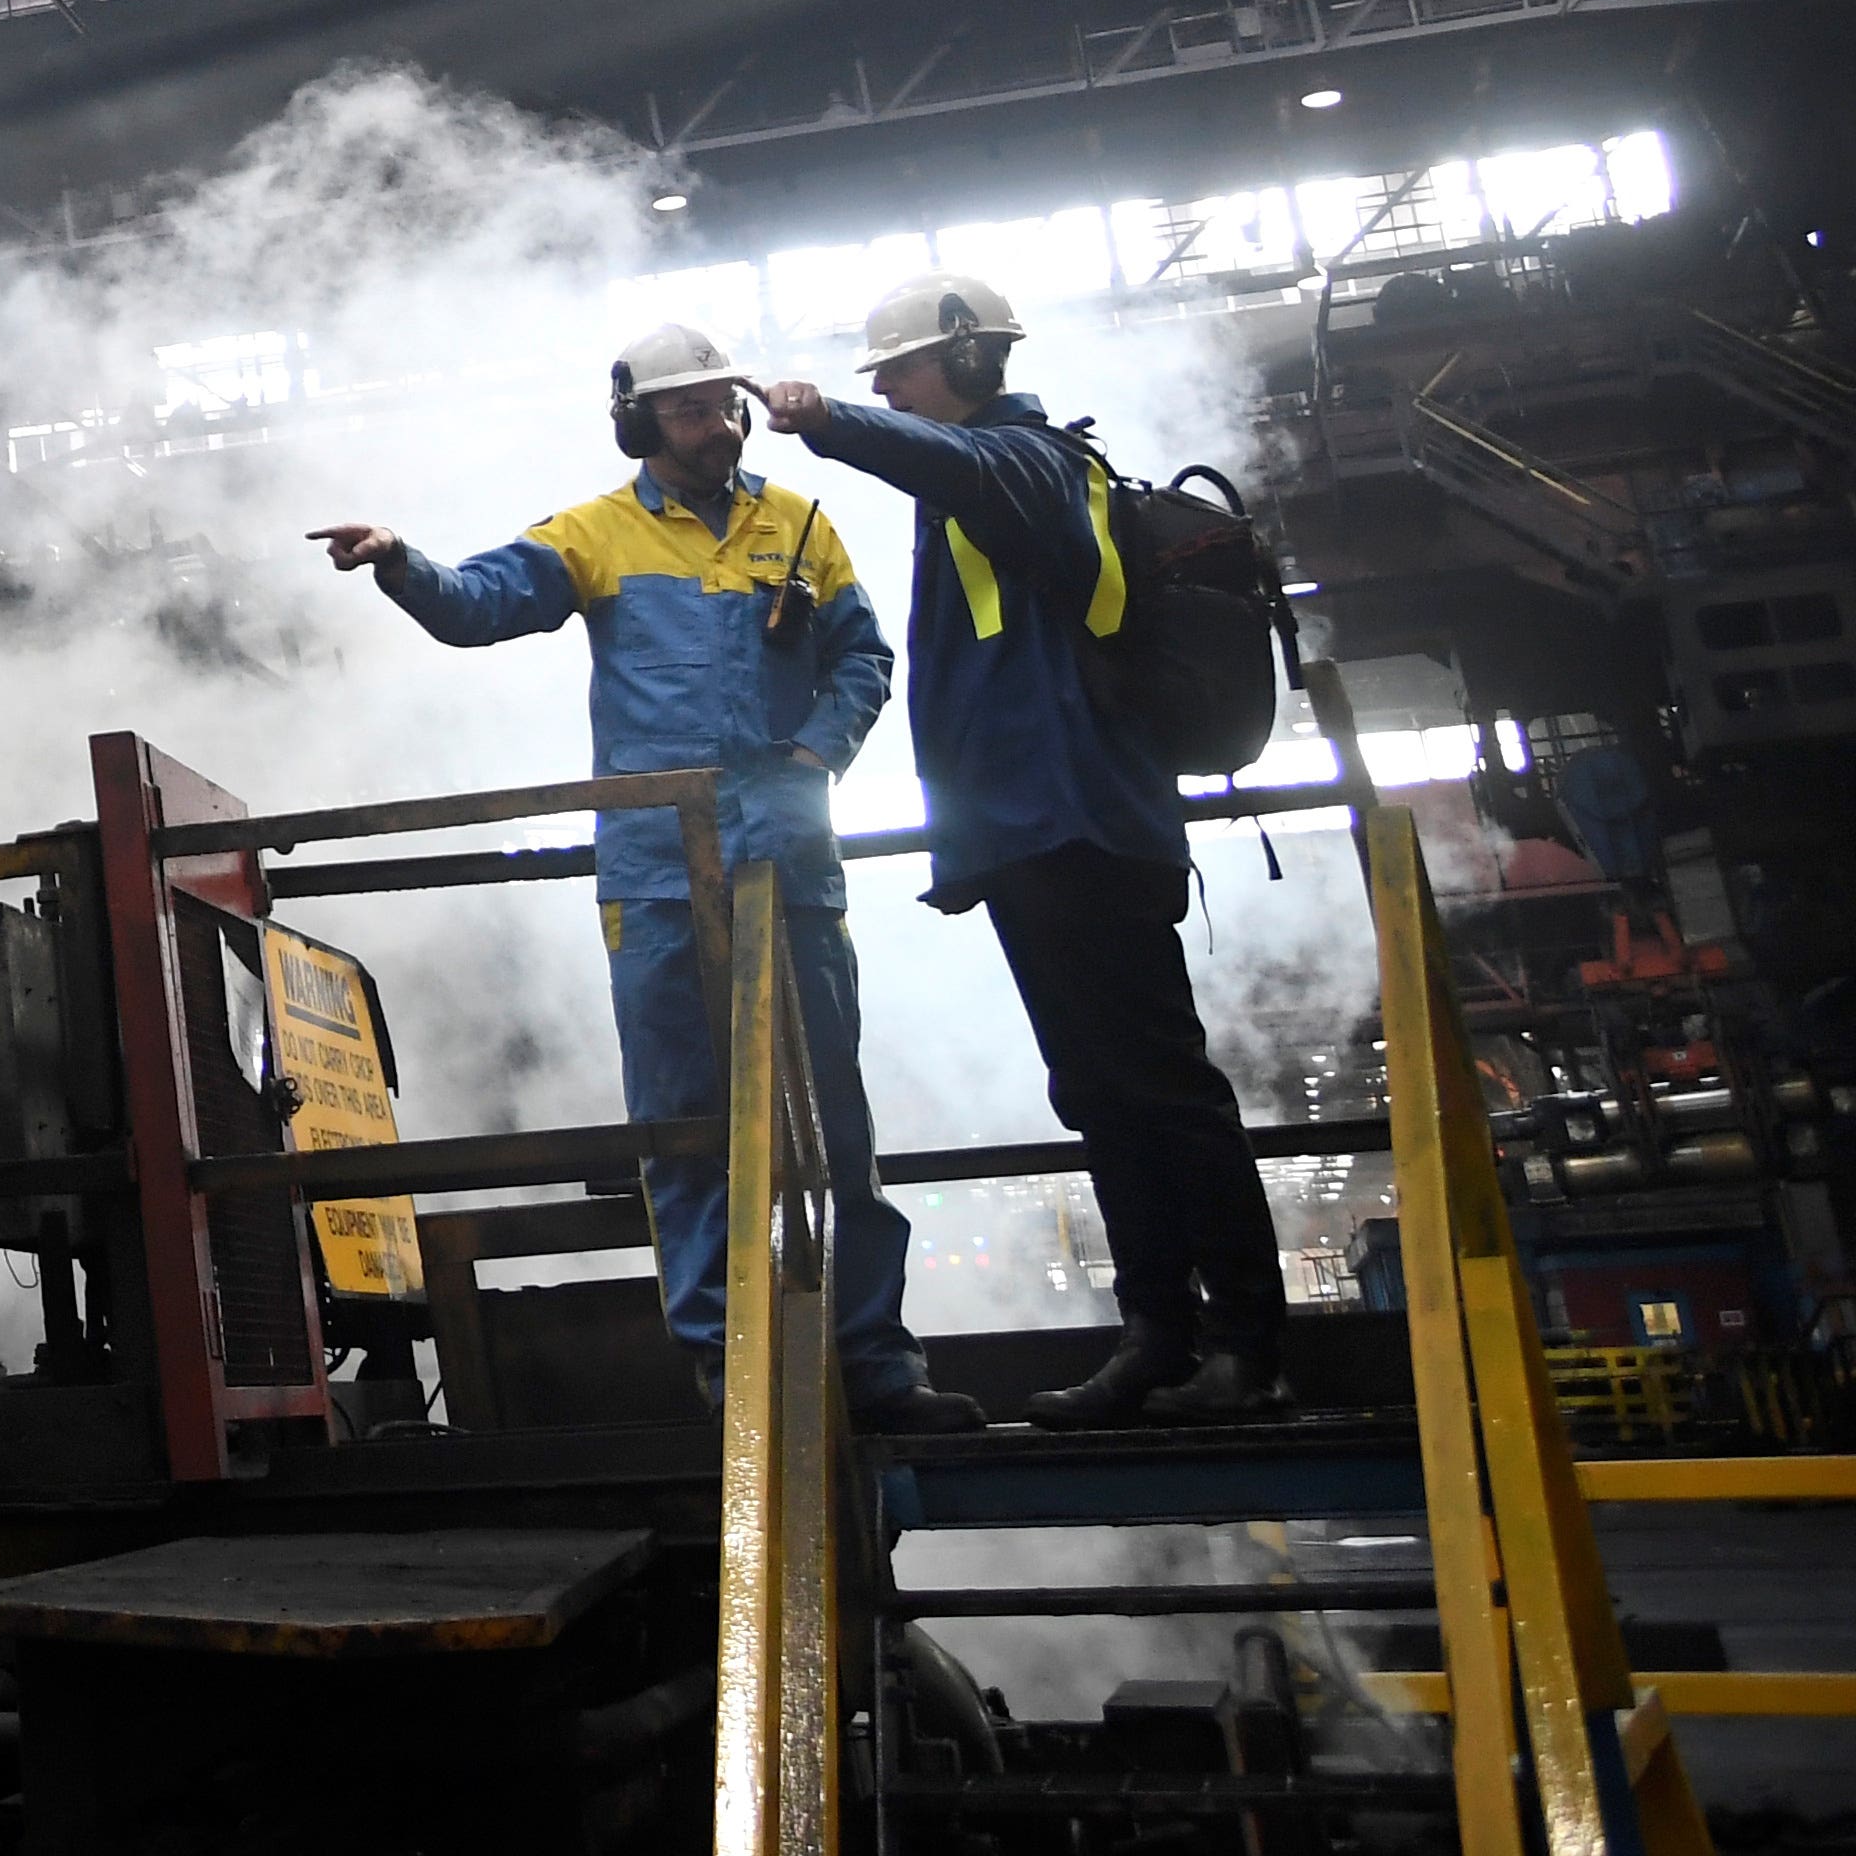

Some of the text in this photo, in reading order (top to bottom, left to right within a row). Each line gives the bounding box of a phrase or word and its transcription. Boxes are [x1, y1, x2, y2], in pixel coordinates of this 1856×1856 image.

[279, 948, 356, 1024] WARNING
[282, 1029, 298, 1061] DO
[298, 1035, 316, 1066] NOT
[319, 1042, 348, 1075] CARRY
[313, 1077, 342, 1109] OVER
[339, 1084, 363, 1115] THIS
[363, 1092, 387, 1120] AREA
[325, 1207, 379, 1240] EQUIPMENT
